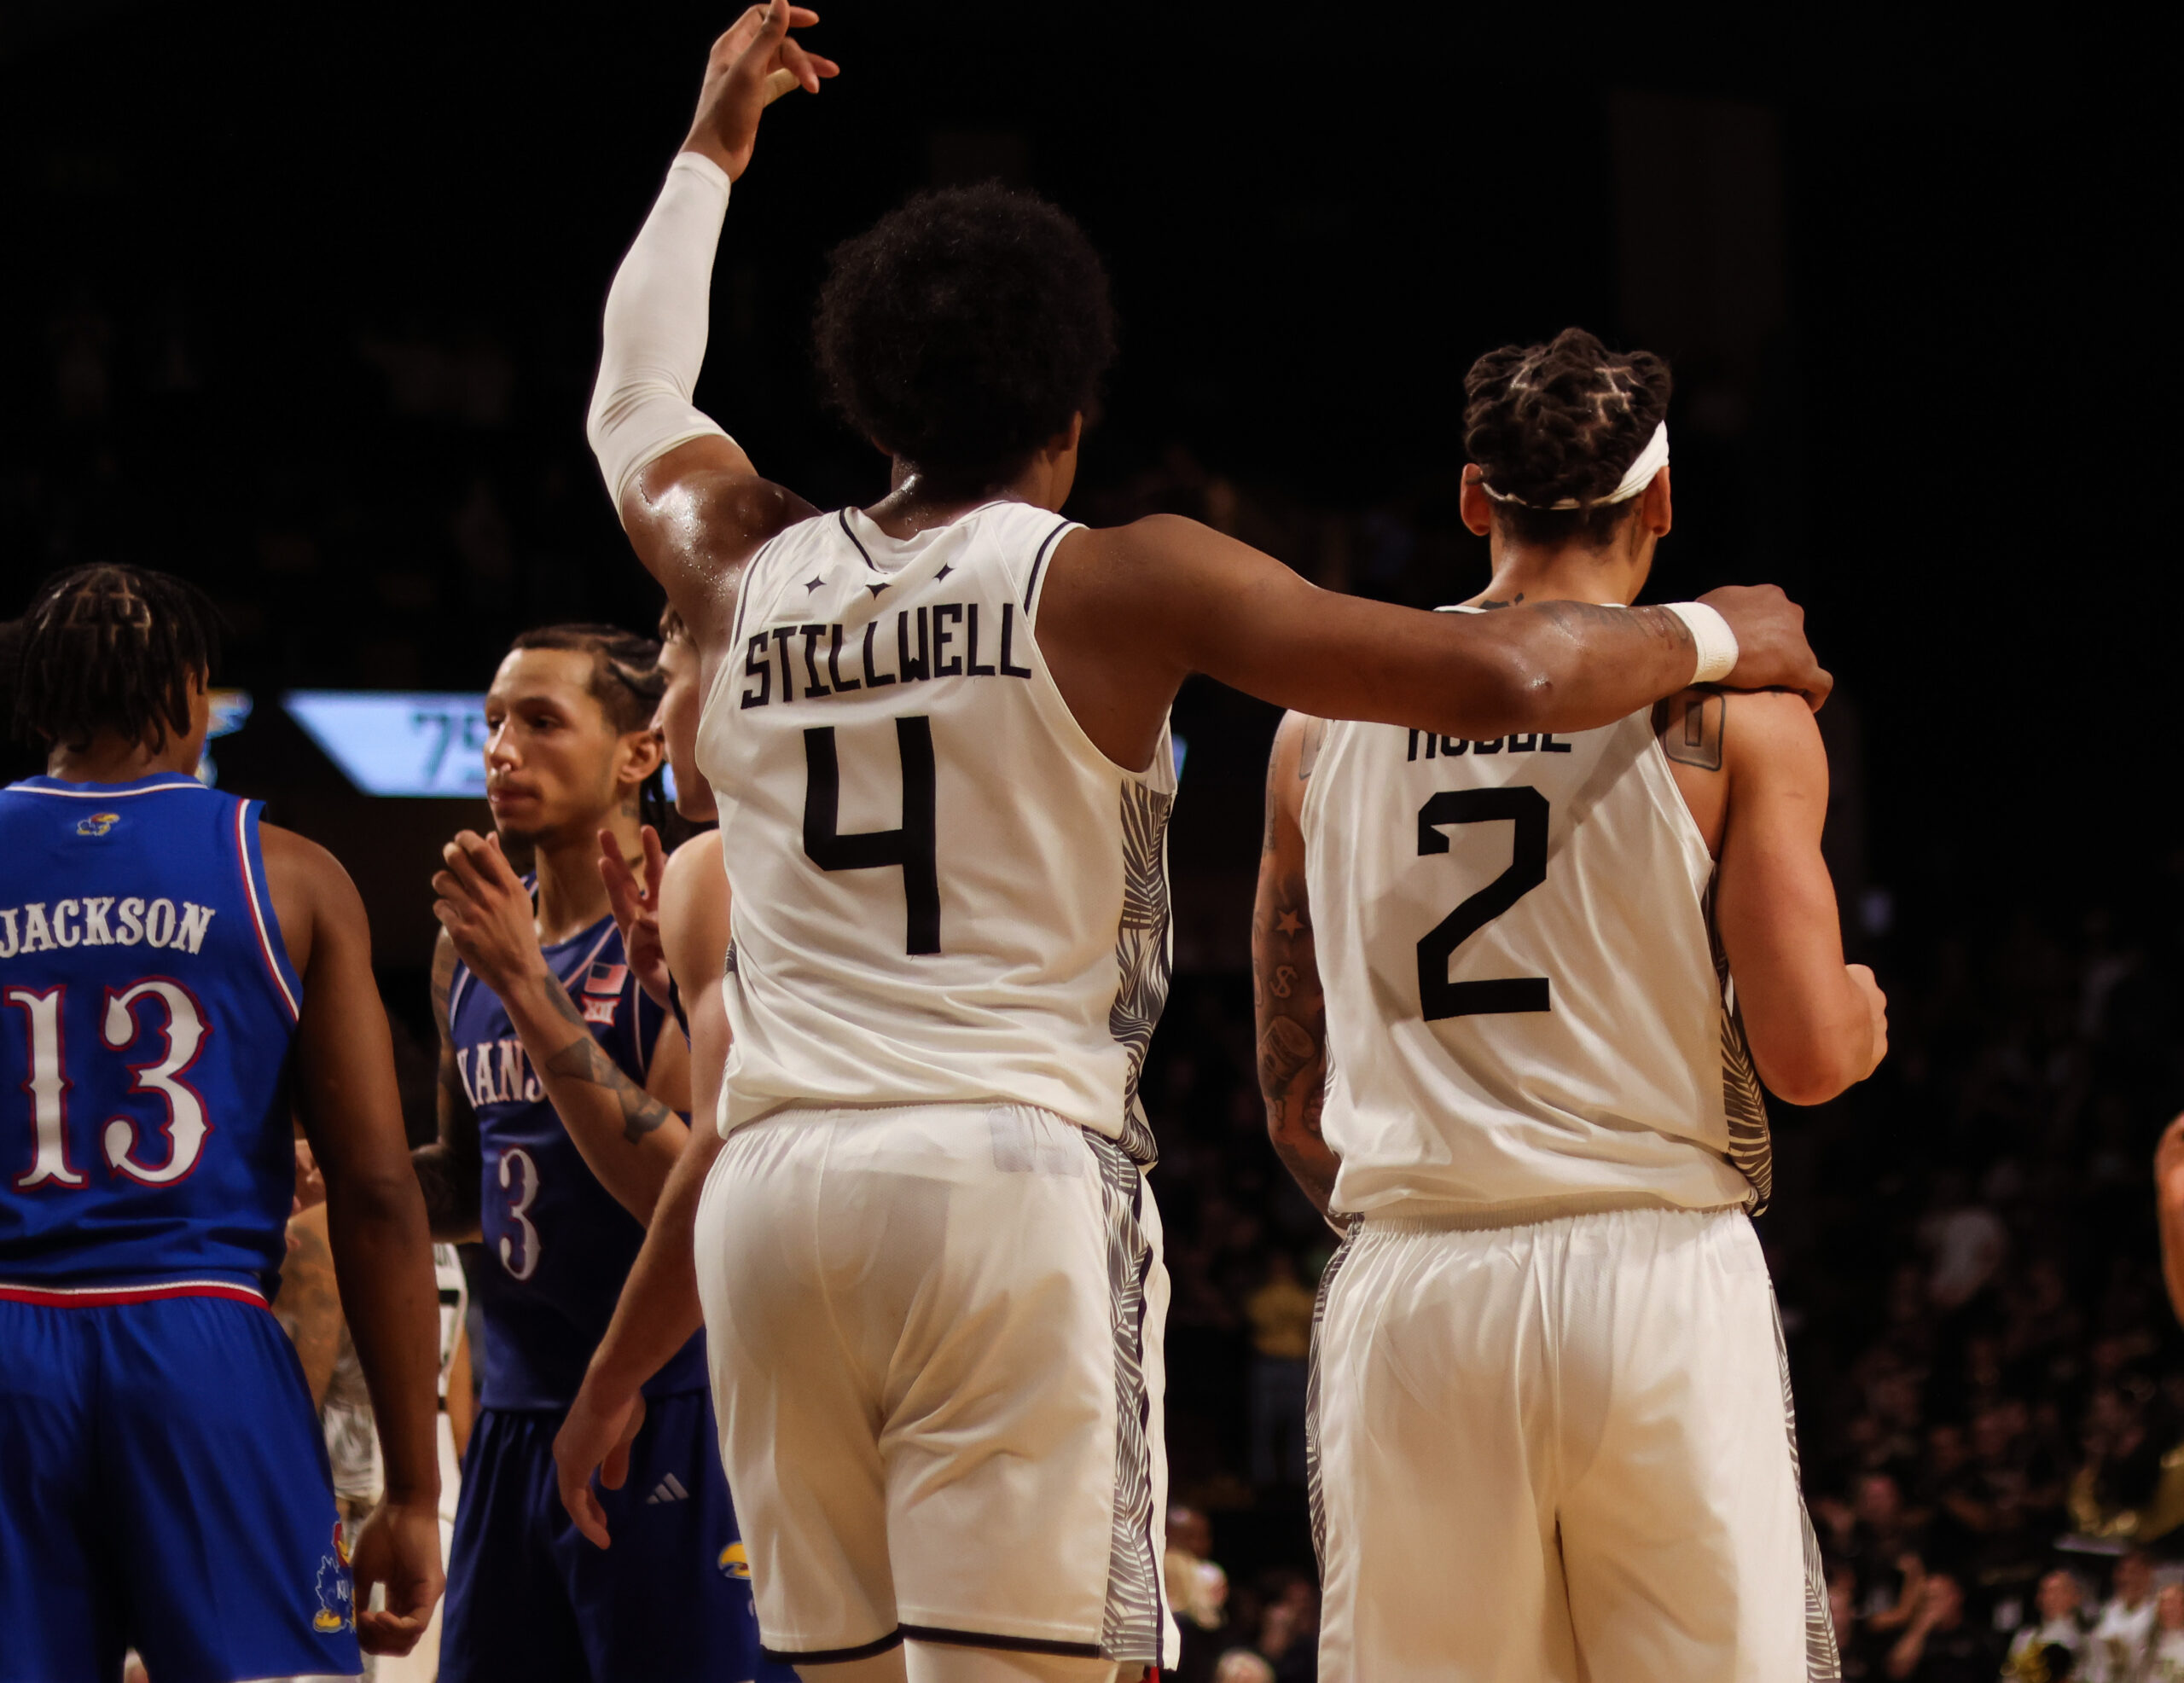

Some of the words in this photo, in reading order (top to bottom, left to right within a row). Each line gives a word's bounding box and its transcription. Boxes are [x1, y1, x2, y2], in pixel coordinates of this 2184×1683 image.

[740, 603, 1032, 710] STILLWELL
[803, 715, 942, 956] 4
[1416, 785, 1552, 1022] 2
[0, 897, 216, 958] JACKSON
[3, 974, 215, 1193] 13
[497, 1143, 543, 1284] 3
